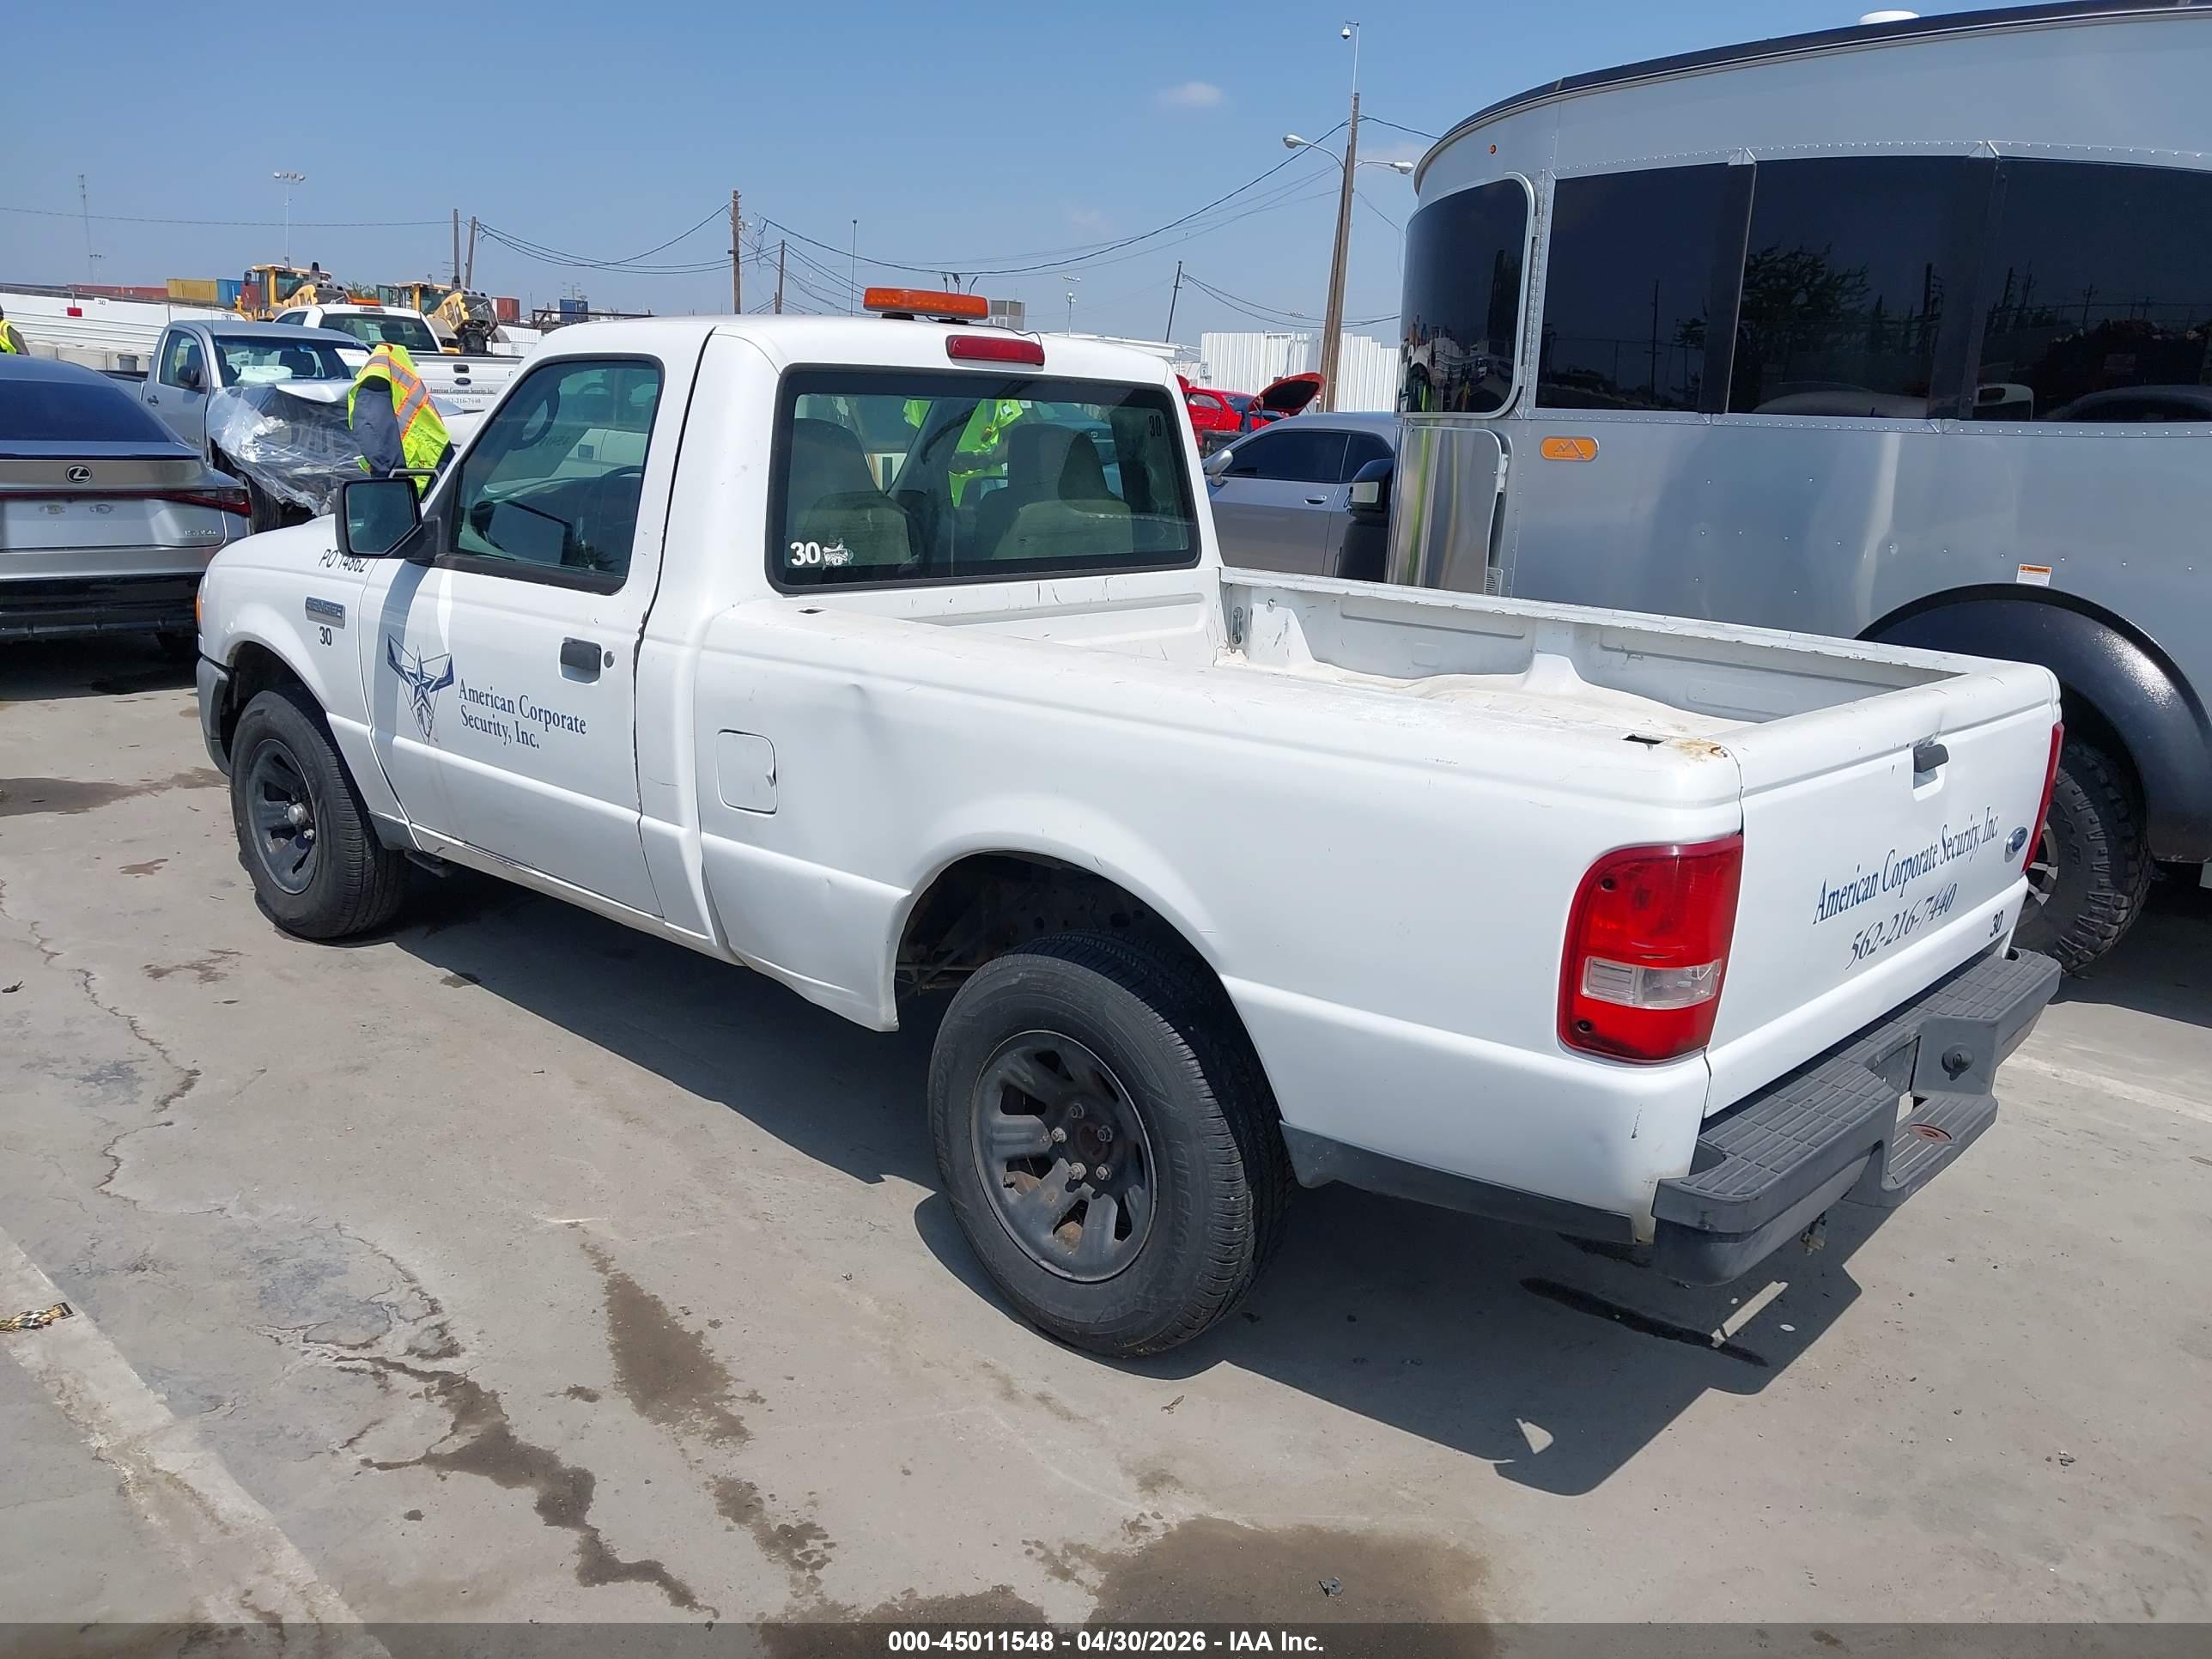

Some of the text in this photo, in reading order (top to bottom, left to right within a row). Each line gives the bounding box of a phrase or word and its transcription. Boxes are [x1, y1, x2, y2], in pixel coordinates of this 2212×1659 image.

[1148, 416, 1162, 437] 30
[318, 549, 339, 568] PO
[790, 542, 821, 566] 30
[319, 626, 332, 647] 30
[459, 678, 586, 735] American Corporate
[460, 705, 540, 749] Security, Inc.
[1813, 864, 1879, 925] American
[1881, 848, 1939, 898] Corporate
[1939, 814, 1980, 866] Security,
[1981, 805, 1999, 844] Inc.
[1845, 883, 1959, 969] 562-216-7440
[1989, 909, 2004, 939] 30
